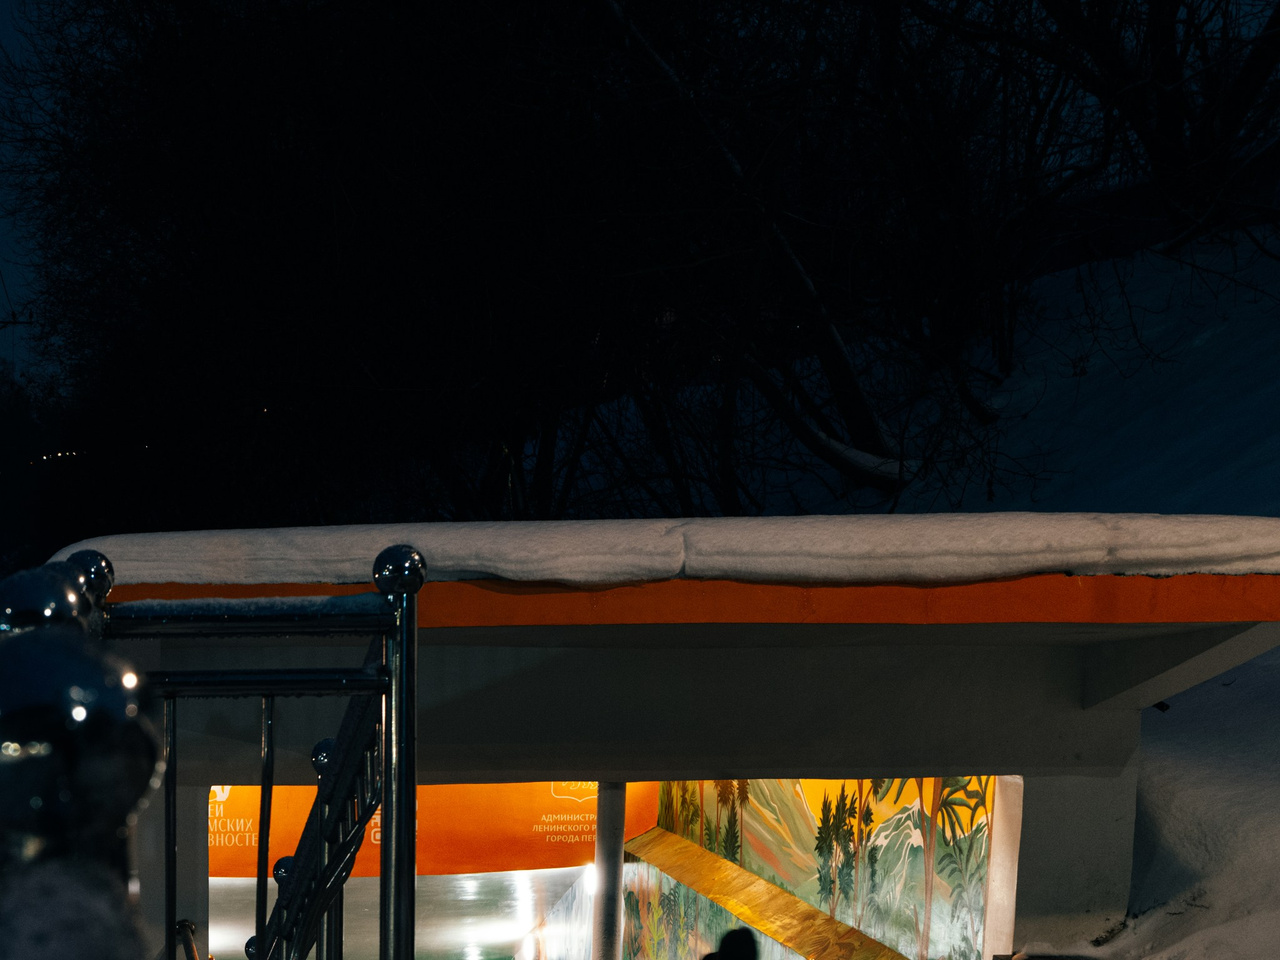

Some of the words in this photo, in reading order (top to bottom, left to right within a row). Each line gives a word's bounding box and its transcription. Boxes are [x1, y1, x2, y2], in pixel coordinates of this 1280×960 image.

[541, 814, 597, 823] АДМИНИСТР
[208, 818, 253, 832] МСКИХ
[532, 824, 590, 832] ЛЕНИНСКОГО
[546, 835, 580, 843] ГОРОДА
